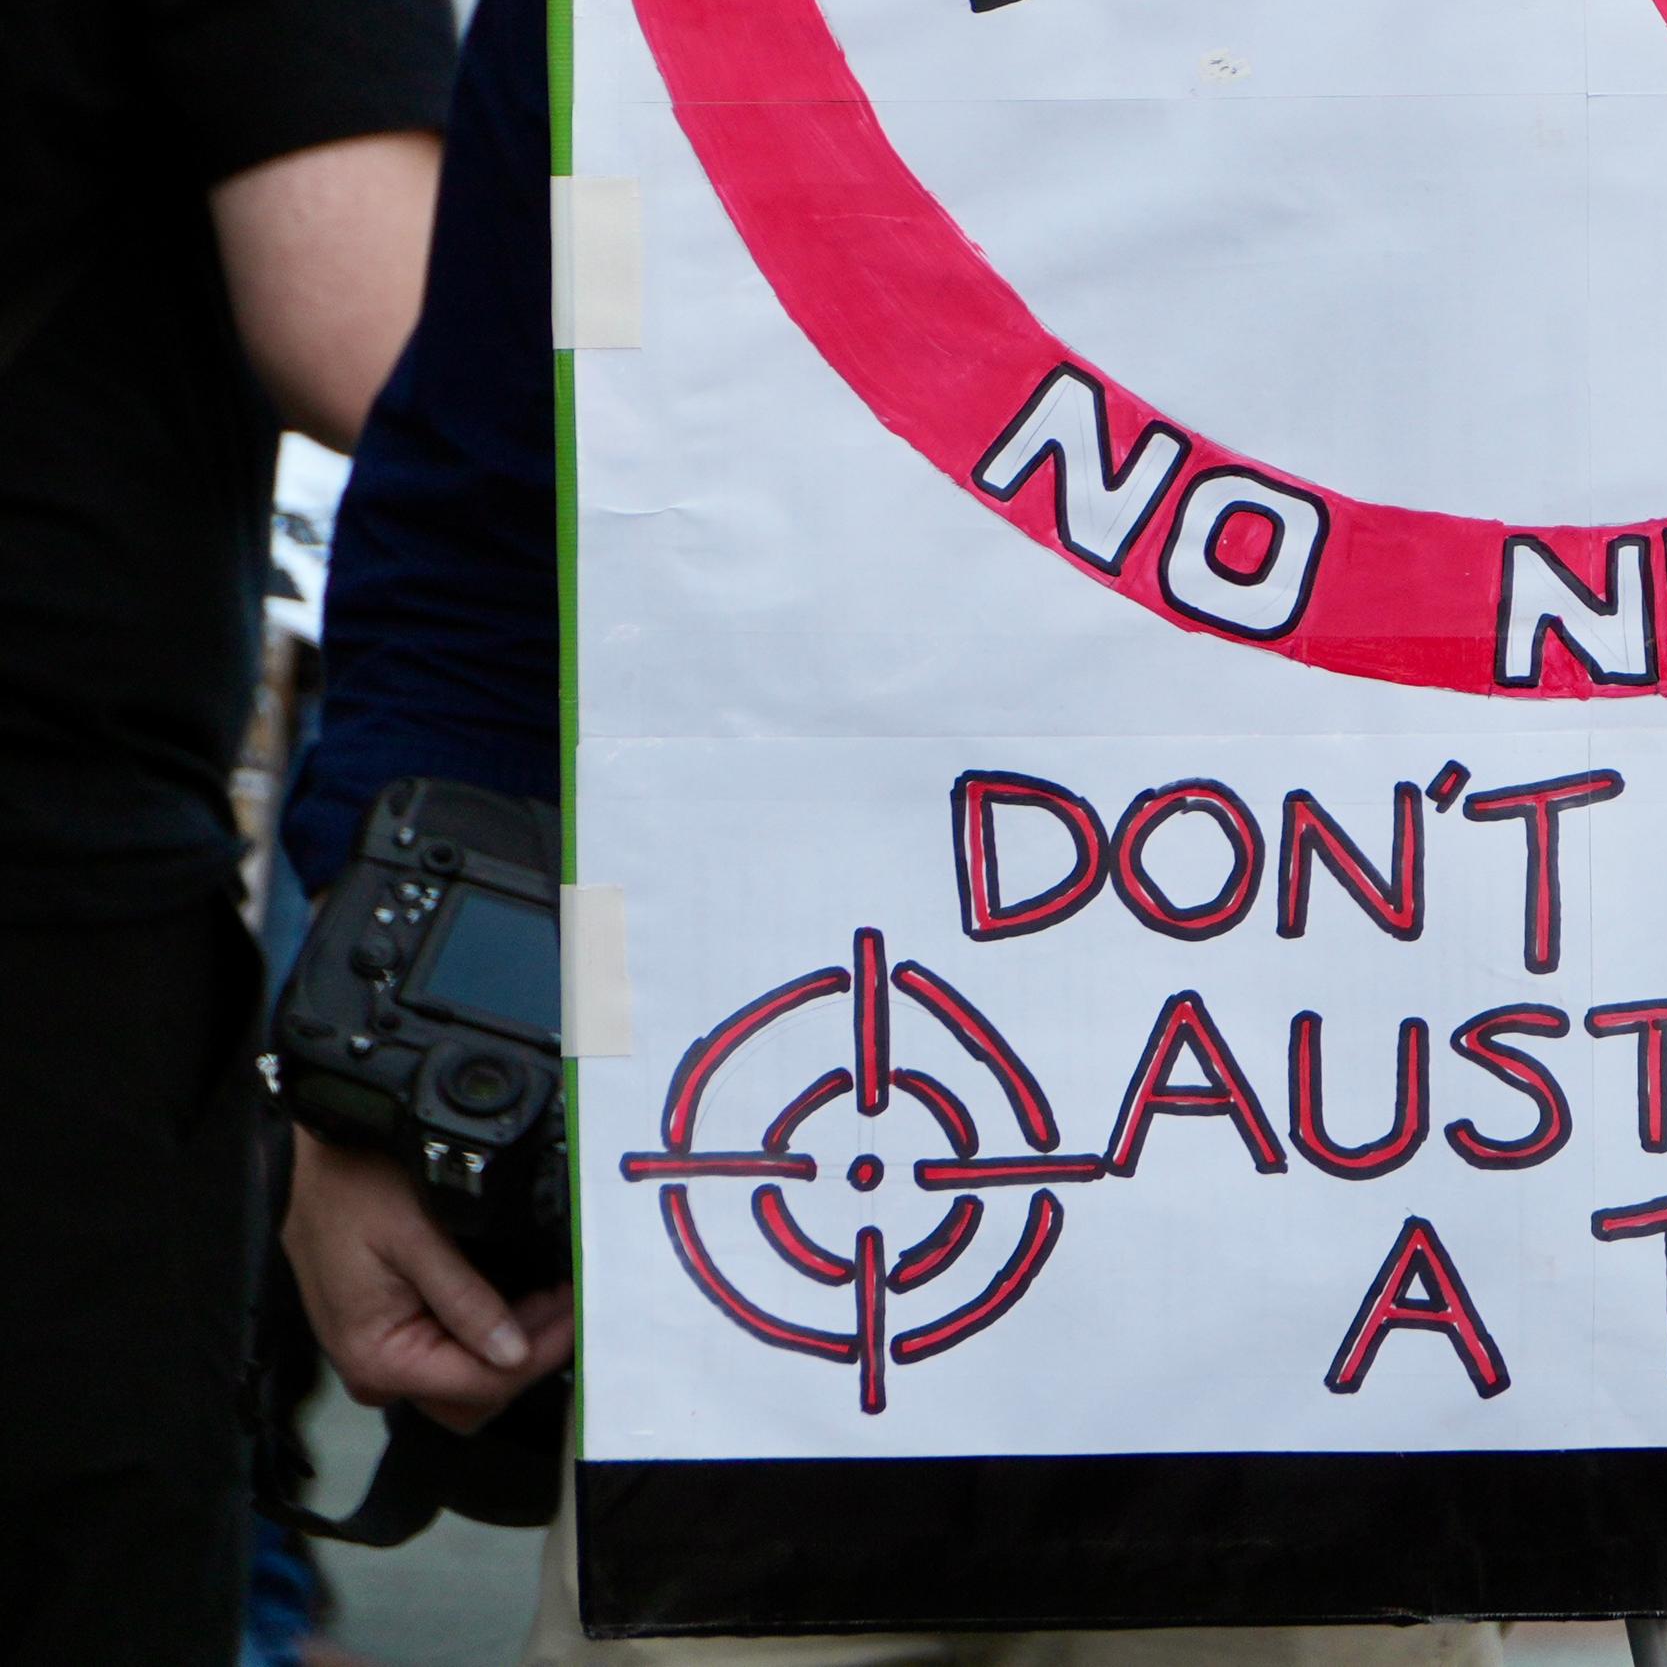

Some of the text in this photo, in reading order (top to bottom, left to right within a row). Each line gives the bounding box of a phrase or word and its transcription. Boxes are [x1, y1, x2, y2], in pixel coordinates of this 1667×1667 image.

[971, 361, 1329, 641] NO
[954, 761, 1624, 972] DON'T
[1324, 1216, 1512, 1400] A
